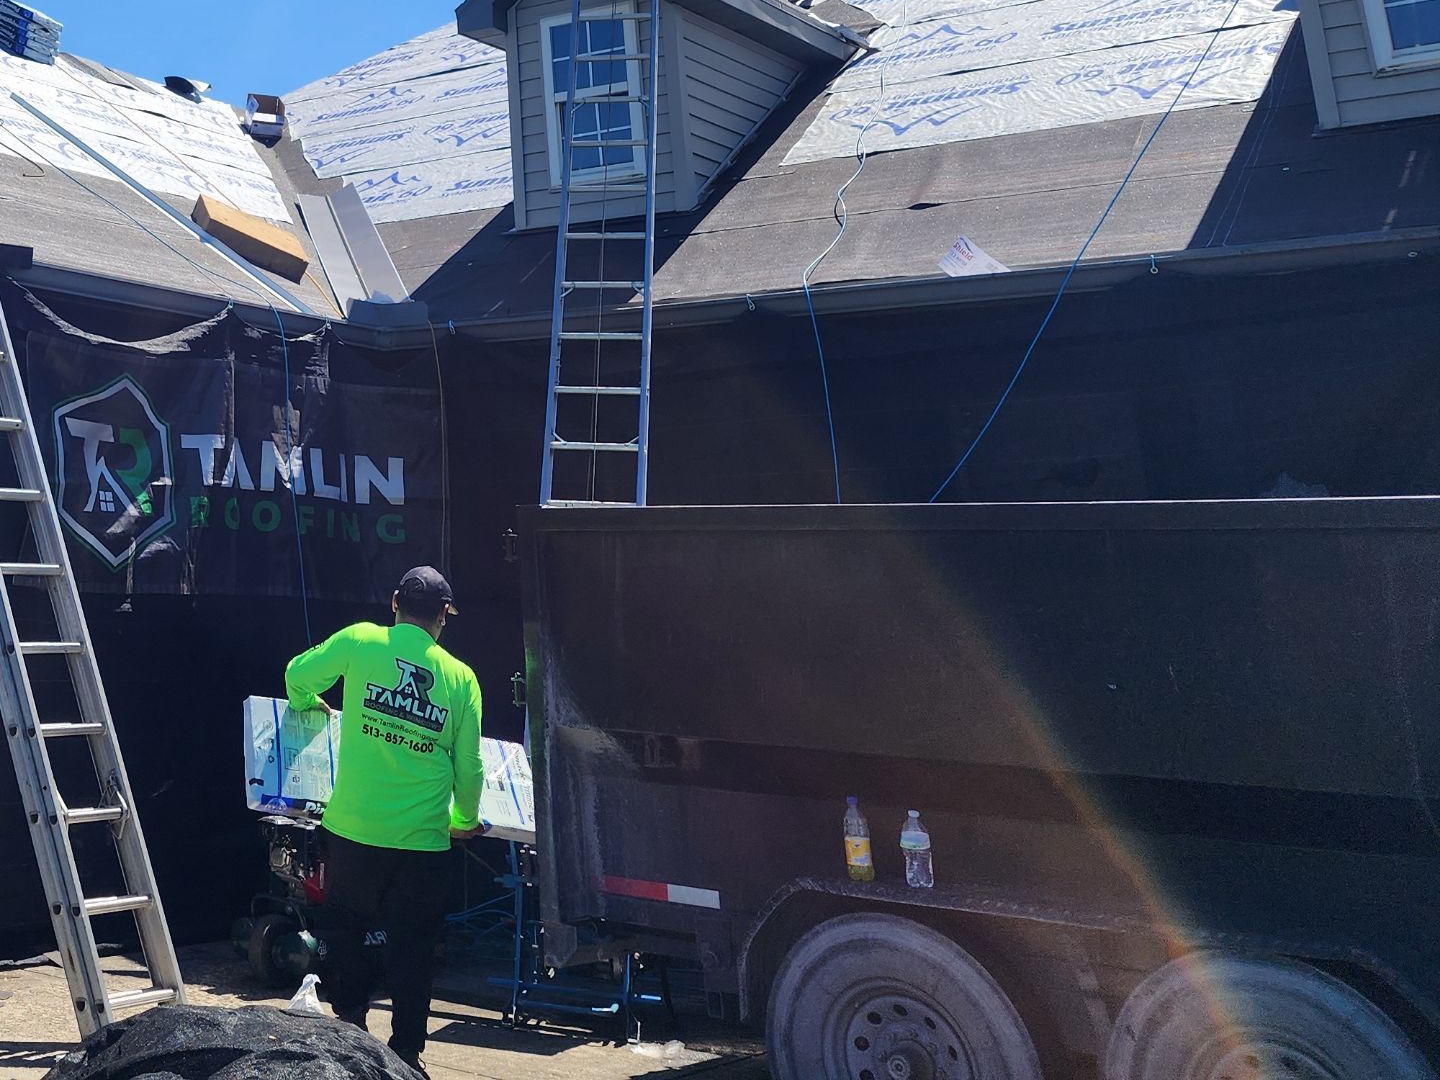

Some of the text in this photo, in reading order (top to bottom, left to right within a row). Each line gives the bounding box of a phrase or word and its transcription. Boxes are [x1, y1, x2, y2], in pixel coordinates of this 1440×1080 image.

[180, 433, 406, 505] TAMLIN
[189, 495, 407, 544] ROOFING
[367, 684, 447, 724] TAMLIN
[362, 724, 434, 754] 513-857-1600
